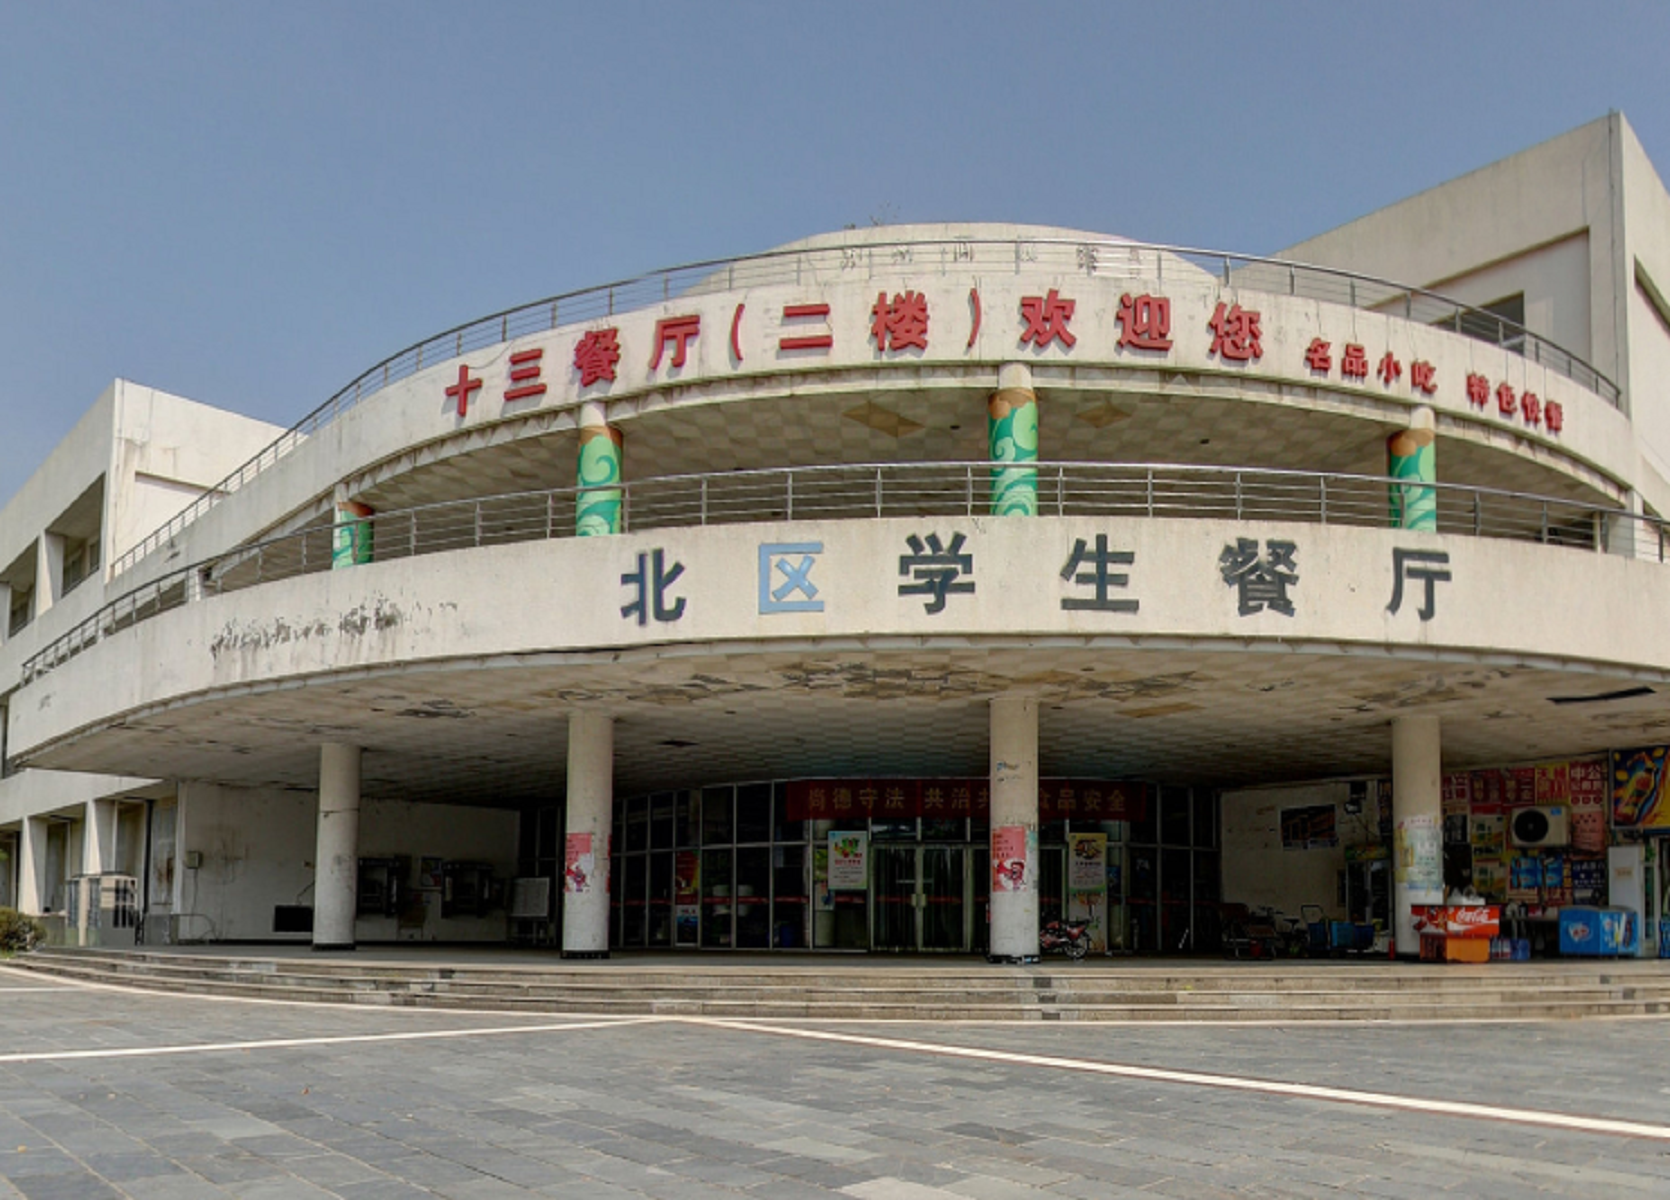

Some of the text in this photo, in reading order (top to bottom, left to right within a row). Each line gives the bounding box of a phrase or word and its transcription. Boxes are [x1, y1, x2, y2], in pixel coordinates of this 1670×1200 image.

[1306, 337, 1437, 394] 名品小吃
[621, 531, 1451, 626] 北区学生餐厅
[808, 787, 905, 810] 尚德守法
